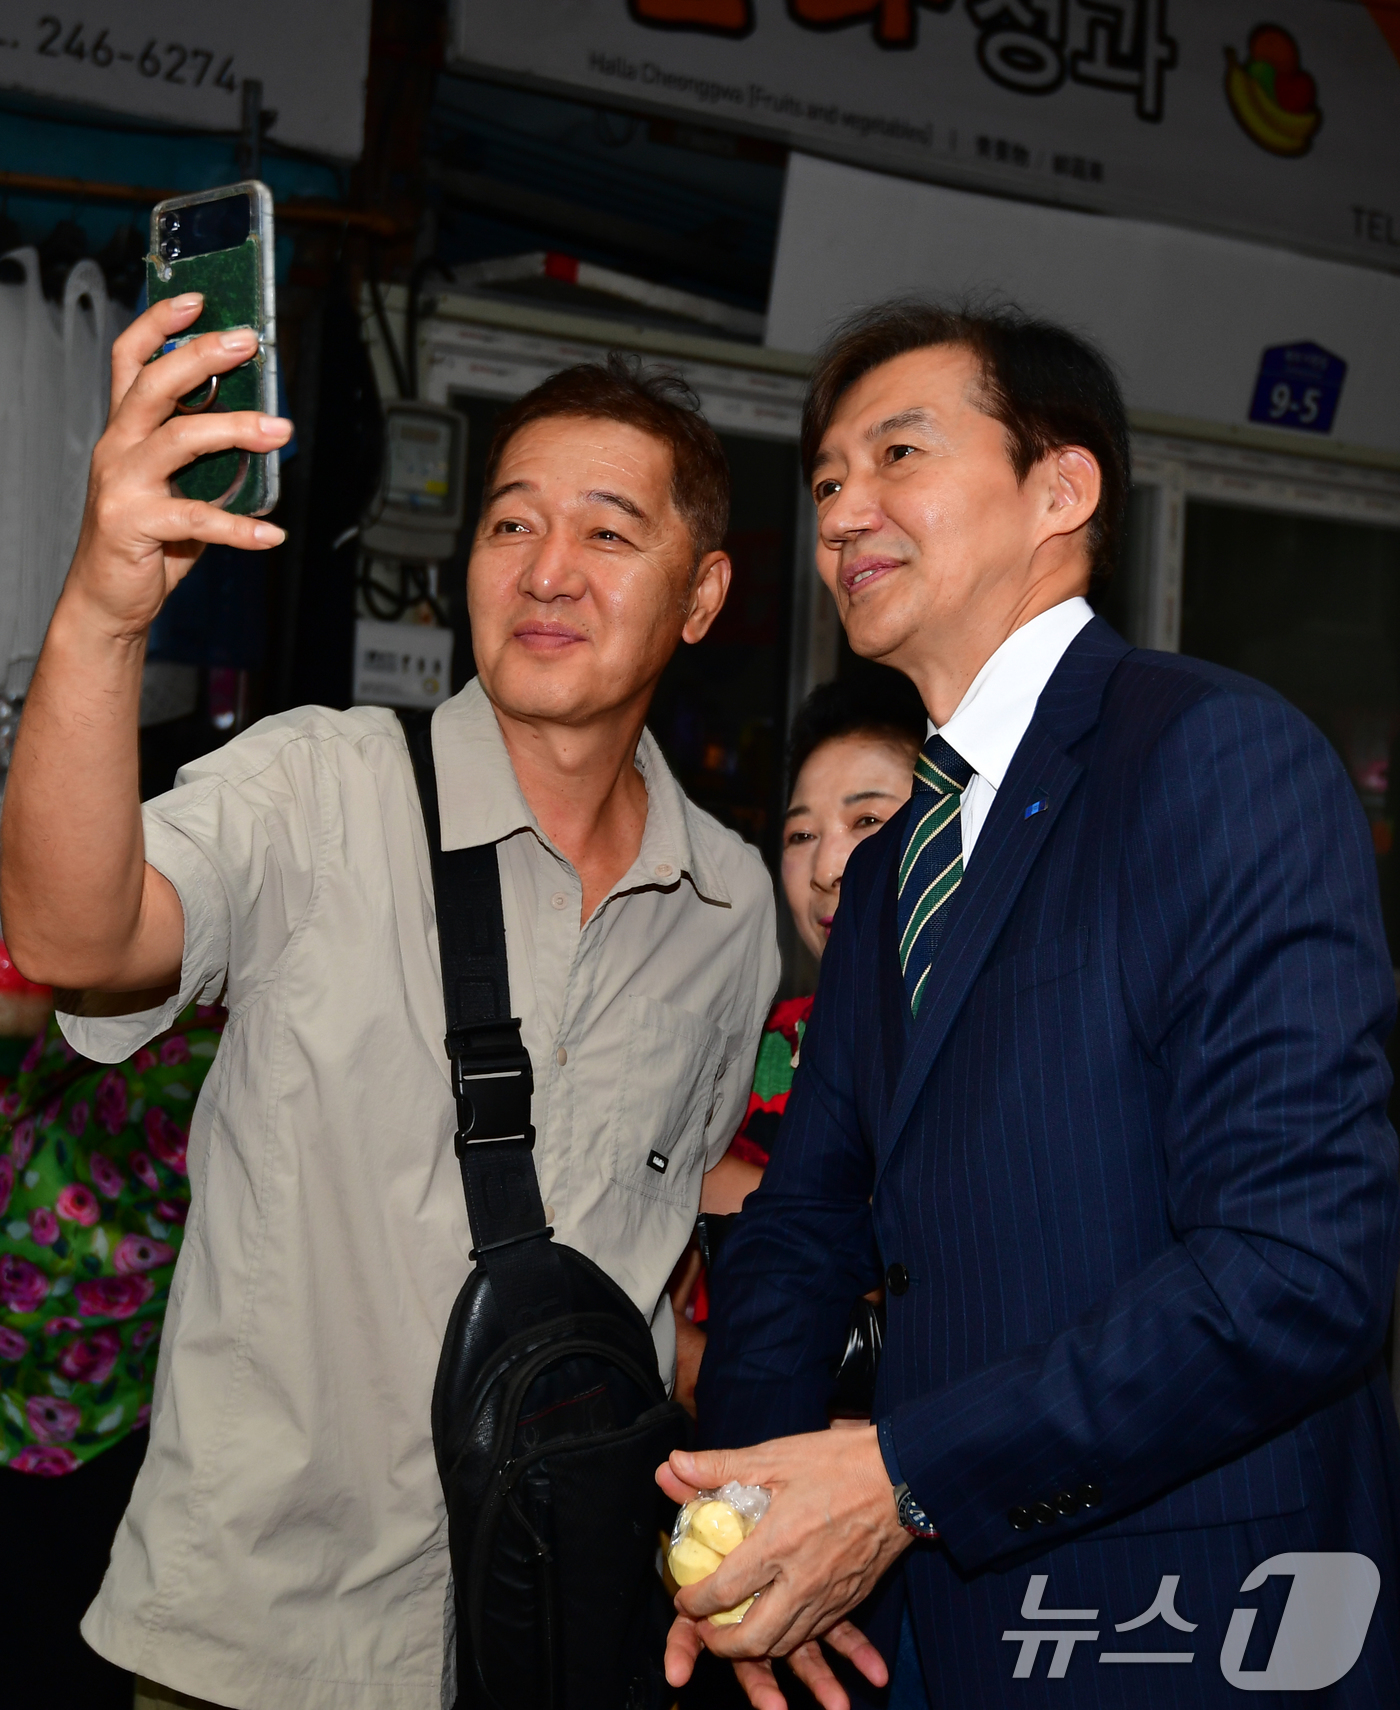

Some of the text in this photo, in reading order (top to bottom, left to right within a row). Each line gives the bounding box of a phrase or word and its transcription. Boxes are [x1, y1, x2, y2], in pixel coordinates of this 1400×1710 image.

[37, 15, 237, 93] 246-6274
[588, 51, 637, 82] Halla
[1267, 380, 1324, 425] 9-5
